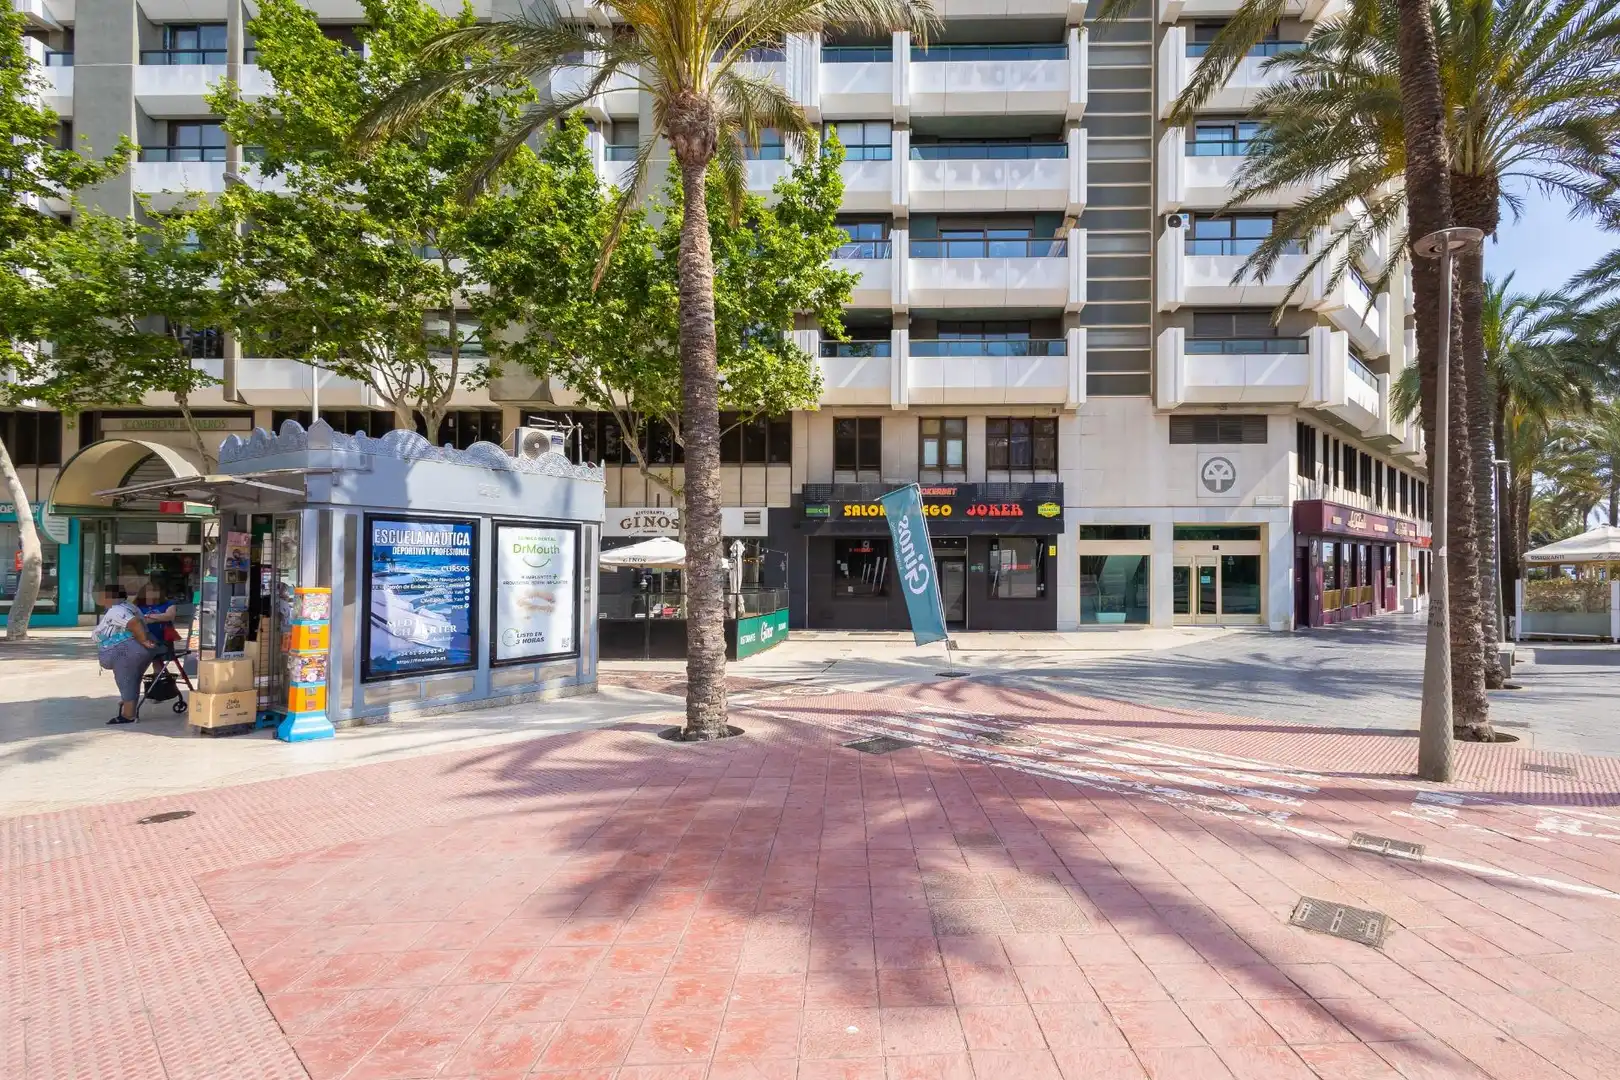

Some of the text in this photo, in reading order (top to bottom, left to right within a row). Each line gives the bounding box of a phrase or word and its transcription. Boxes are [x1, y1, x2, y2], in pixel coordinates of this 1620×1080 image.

[921, 504, 952, 516] EGO
[966, 503, 1024, 516] JOKER
[620, 516, 681, 530] GINOS
[374, 528, 423, 545] ESCUELA
[392, 546, 471, 556] DEPORTIVA Y PROFESIONAL
[513, 543, 561, 555] DrMouth
[898, 515, 930, 595] Ginos
[441, 565, 470, 573] CURSOS
